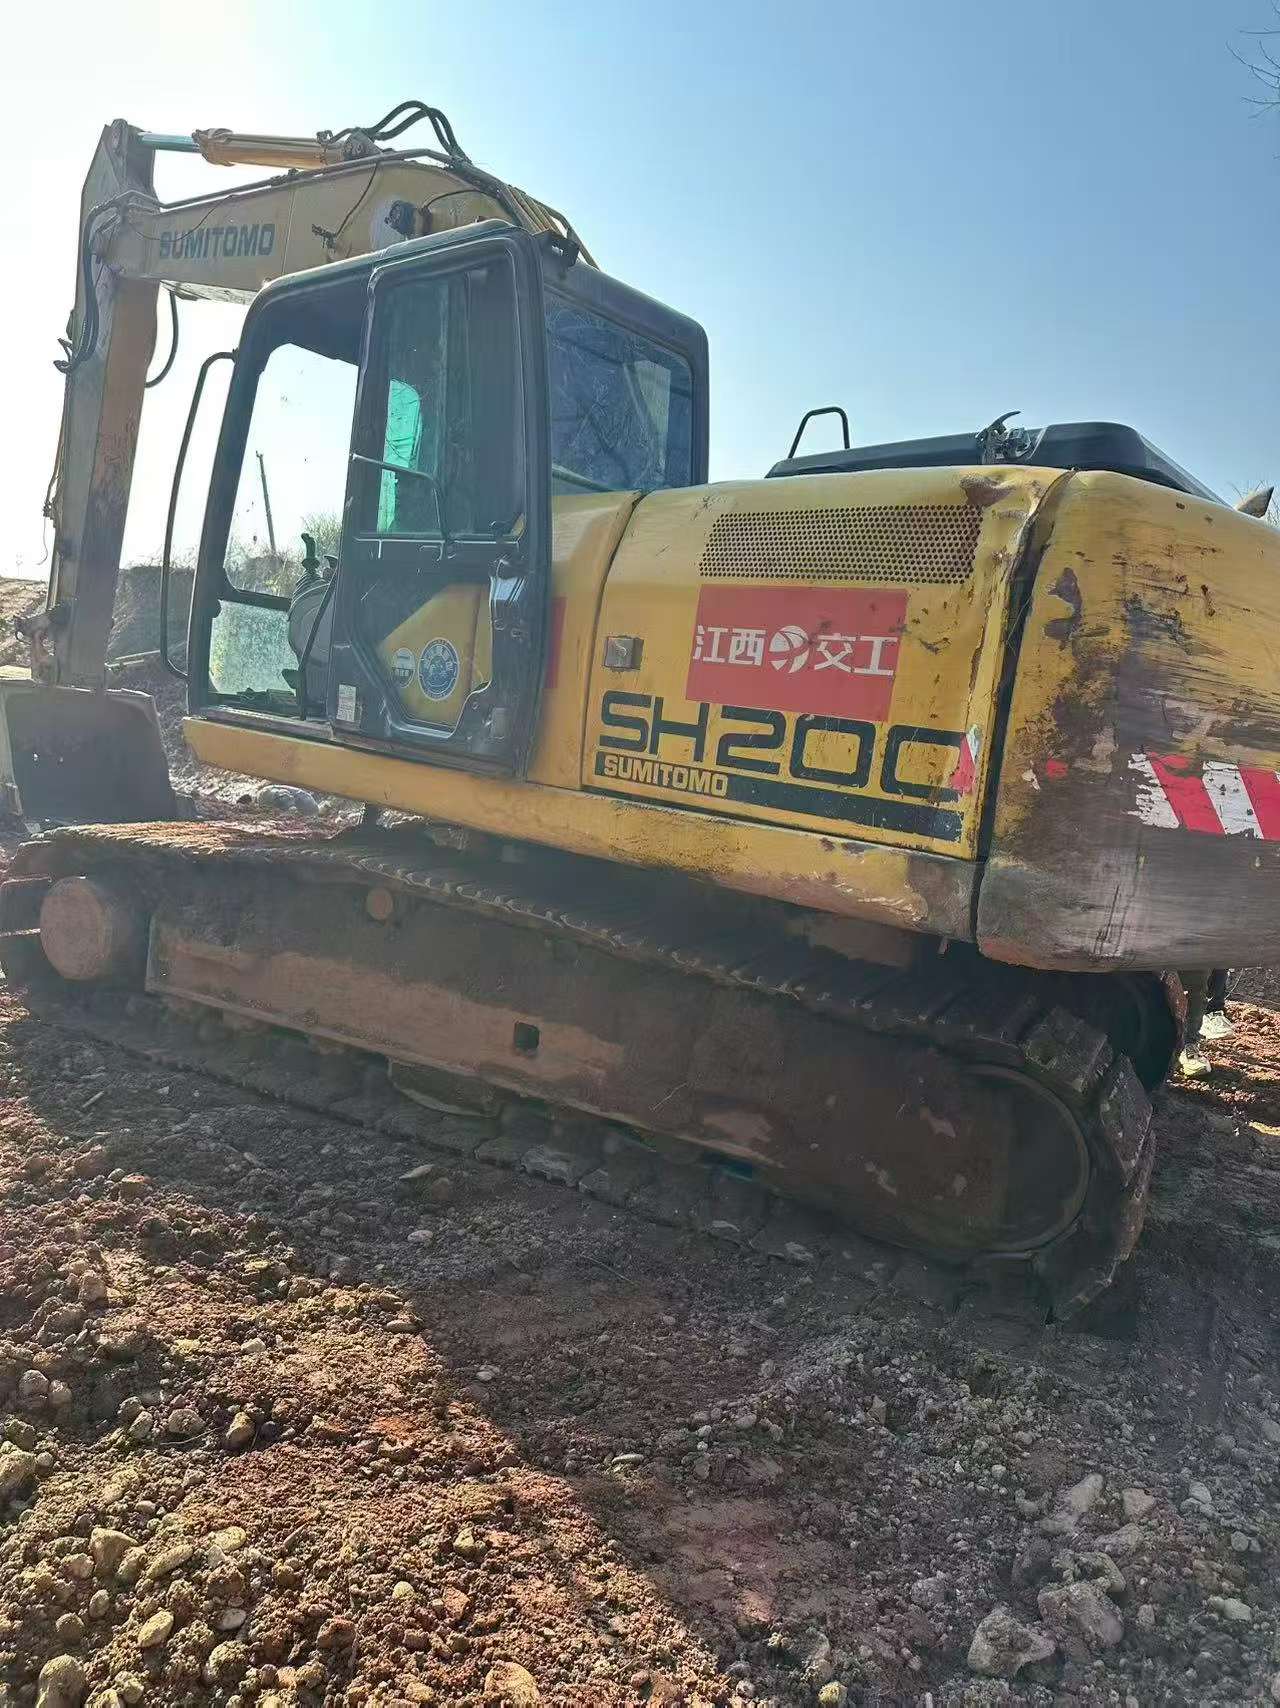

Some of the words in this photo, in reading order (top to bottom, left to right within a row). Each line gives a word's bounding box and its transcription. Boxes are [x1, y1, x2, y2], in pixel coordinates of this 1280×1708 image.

[160, 224, 275, 259] SUMITOMO
[693, 624, 767, 666] 江西
[814, 632, 898, 676] 交工
[604, 754, 728, 798] SUMITOMO
